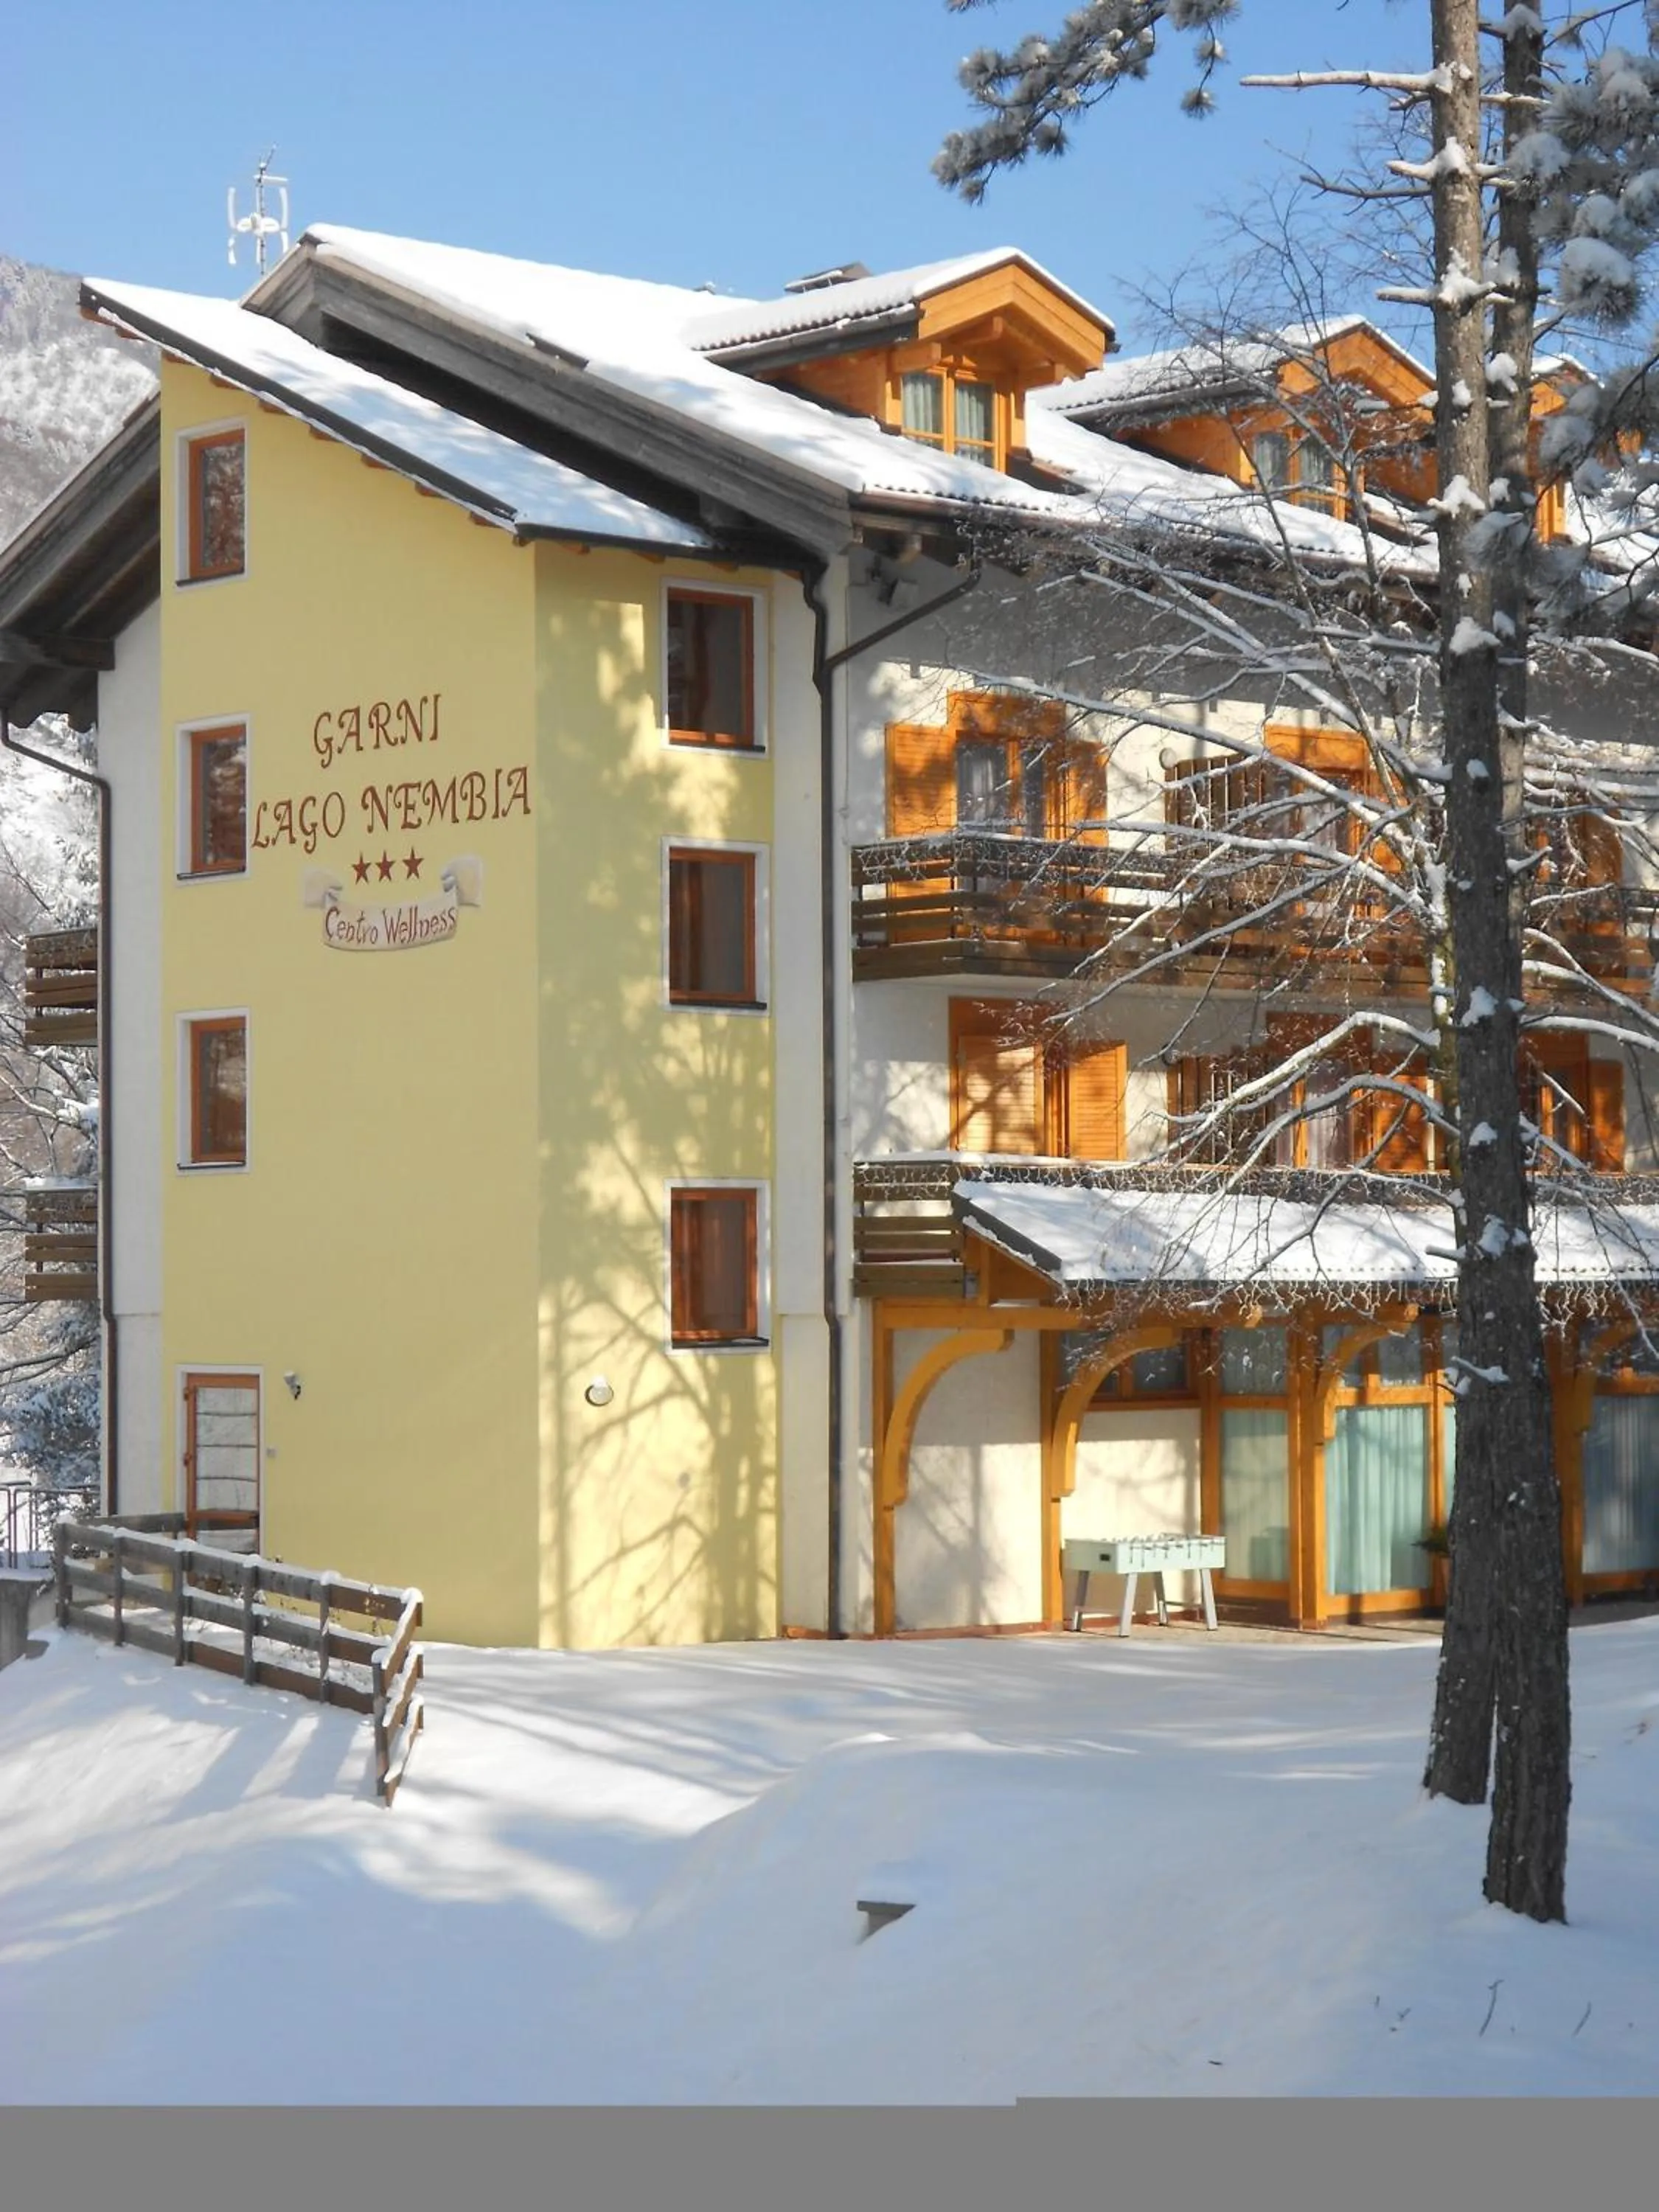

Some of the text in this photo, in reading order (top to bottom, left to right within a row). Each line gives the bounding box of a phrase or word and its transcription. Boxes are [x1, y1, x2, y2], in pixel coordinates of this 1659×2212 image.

[313, 694, 441, 769] GARNI
[251, 766, 532, 854] LAGO NEMBIA
[324, 906, 456, 945] Centro Wellness
